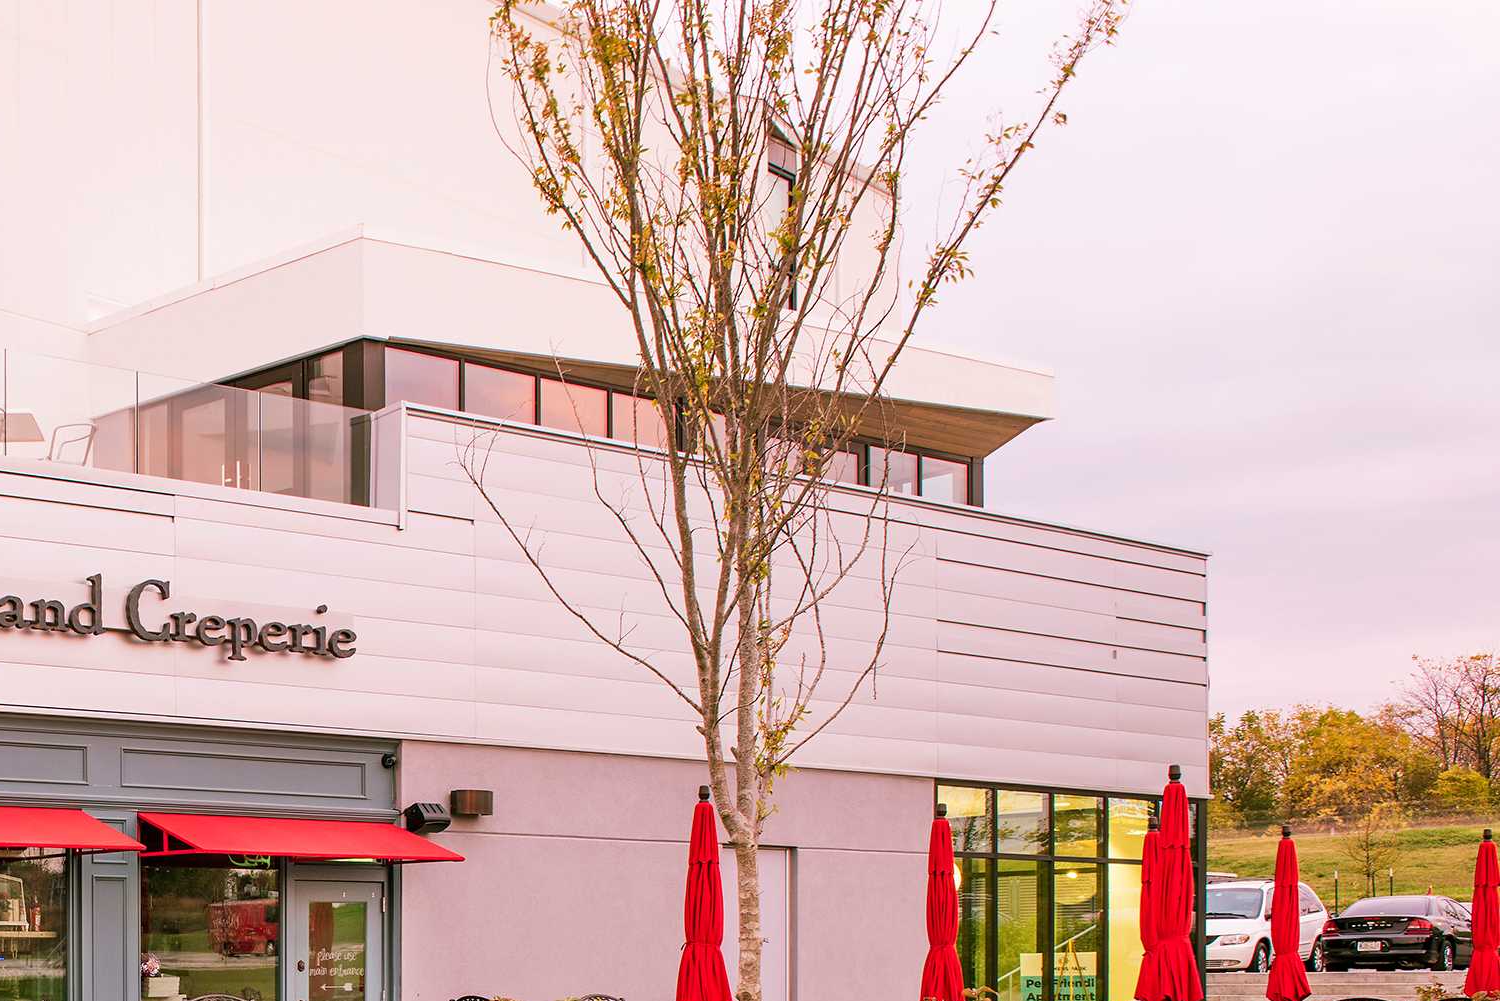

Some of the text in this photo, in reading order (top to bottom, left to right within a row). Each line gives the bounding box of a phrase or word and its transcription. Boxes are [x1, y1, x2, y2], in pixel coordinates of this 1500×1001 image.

[125, 578, 357, 661] Creperie
[316, 948, 357, 967] please use
[309, 963, 365, 977] main entrance
